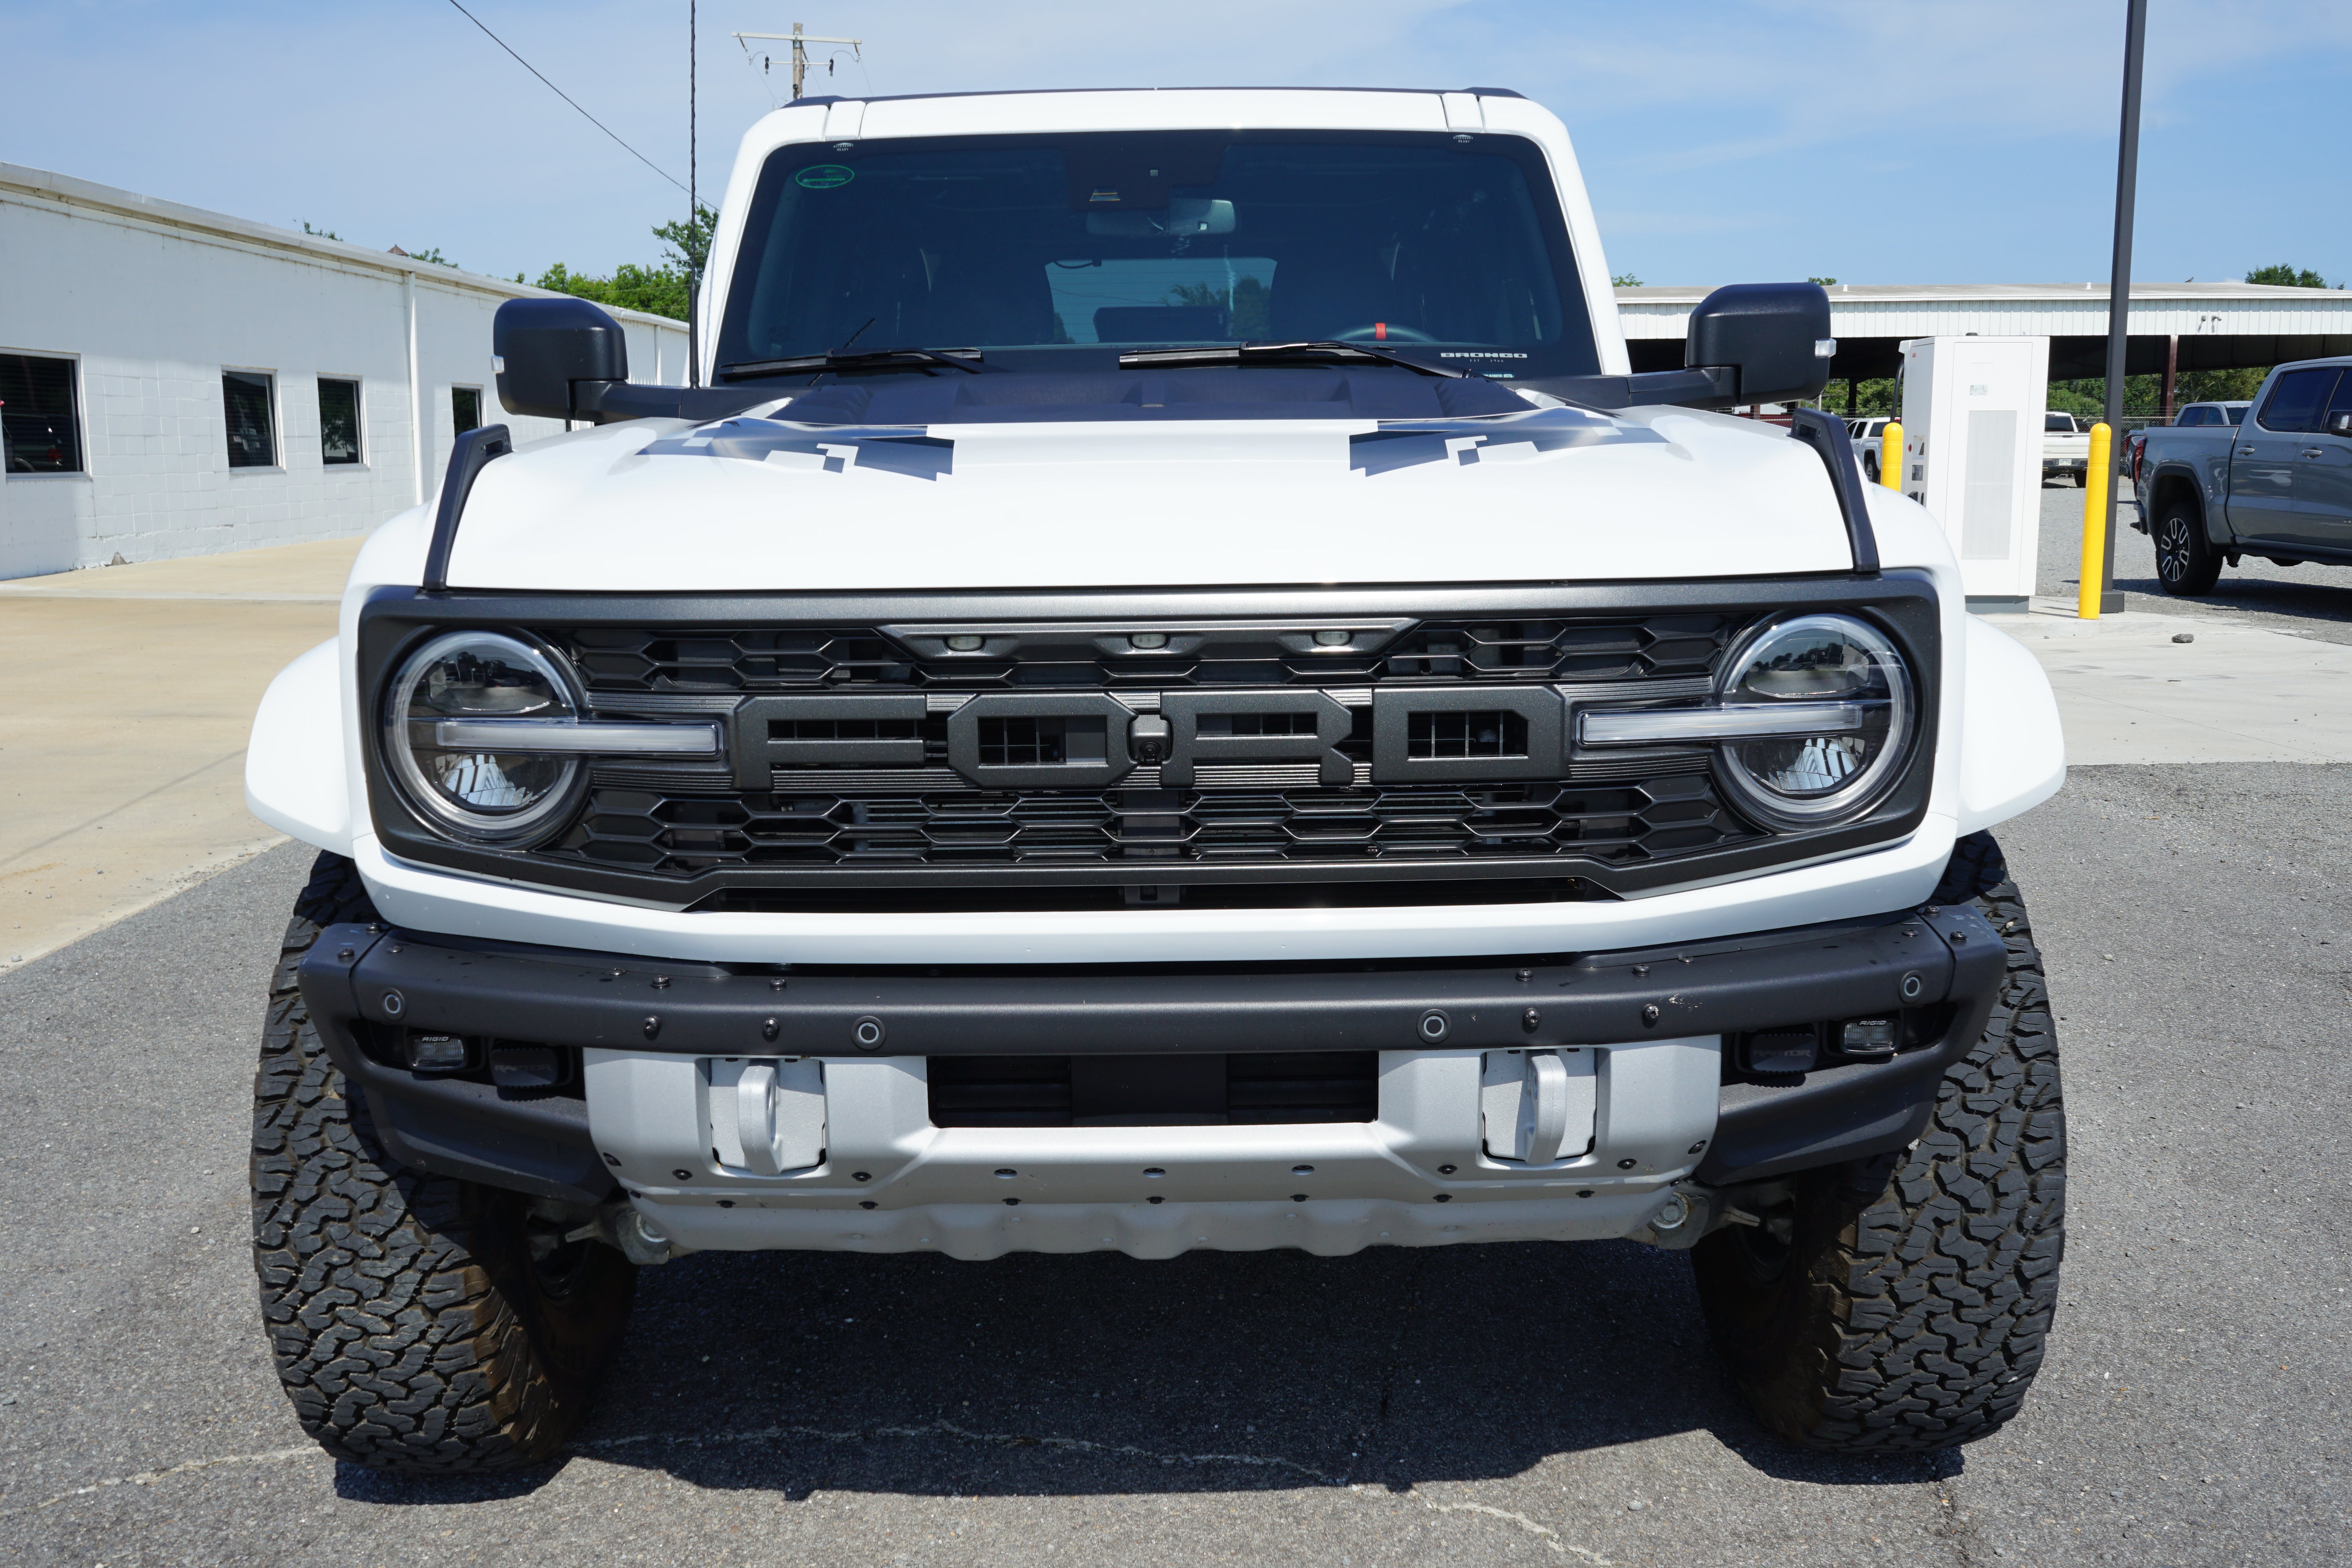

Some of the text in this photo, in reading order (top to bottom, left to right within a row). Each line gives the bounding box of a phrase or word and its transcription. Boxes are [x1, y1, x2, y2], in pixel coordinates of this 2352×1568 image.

[737, 686, 1565, 788] FORD
[1752, 1049, 1812, 1058] RAPTOR
[494, 1064, 554, 1073] RAPTOR
